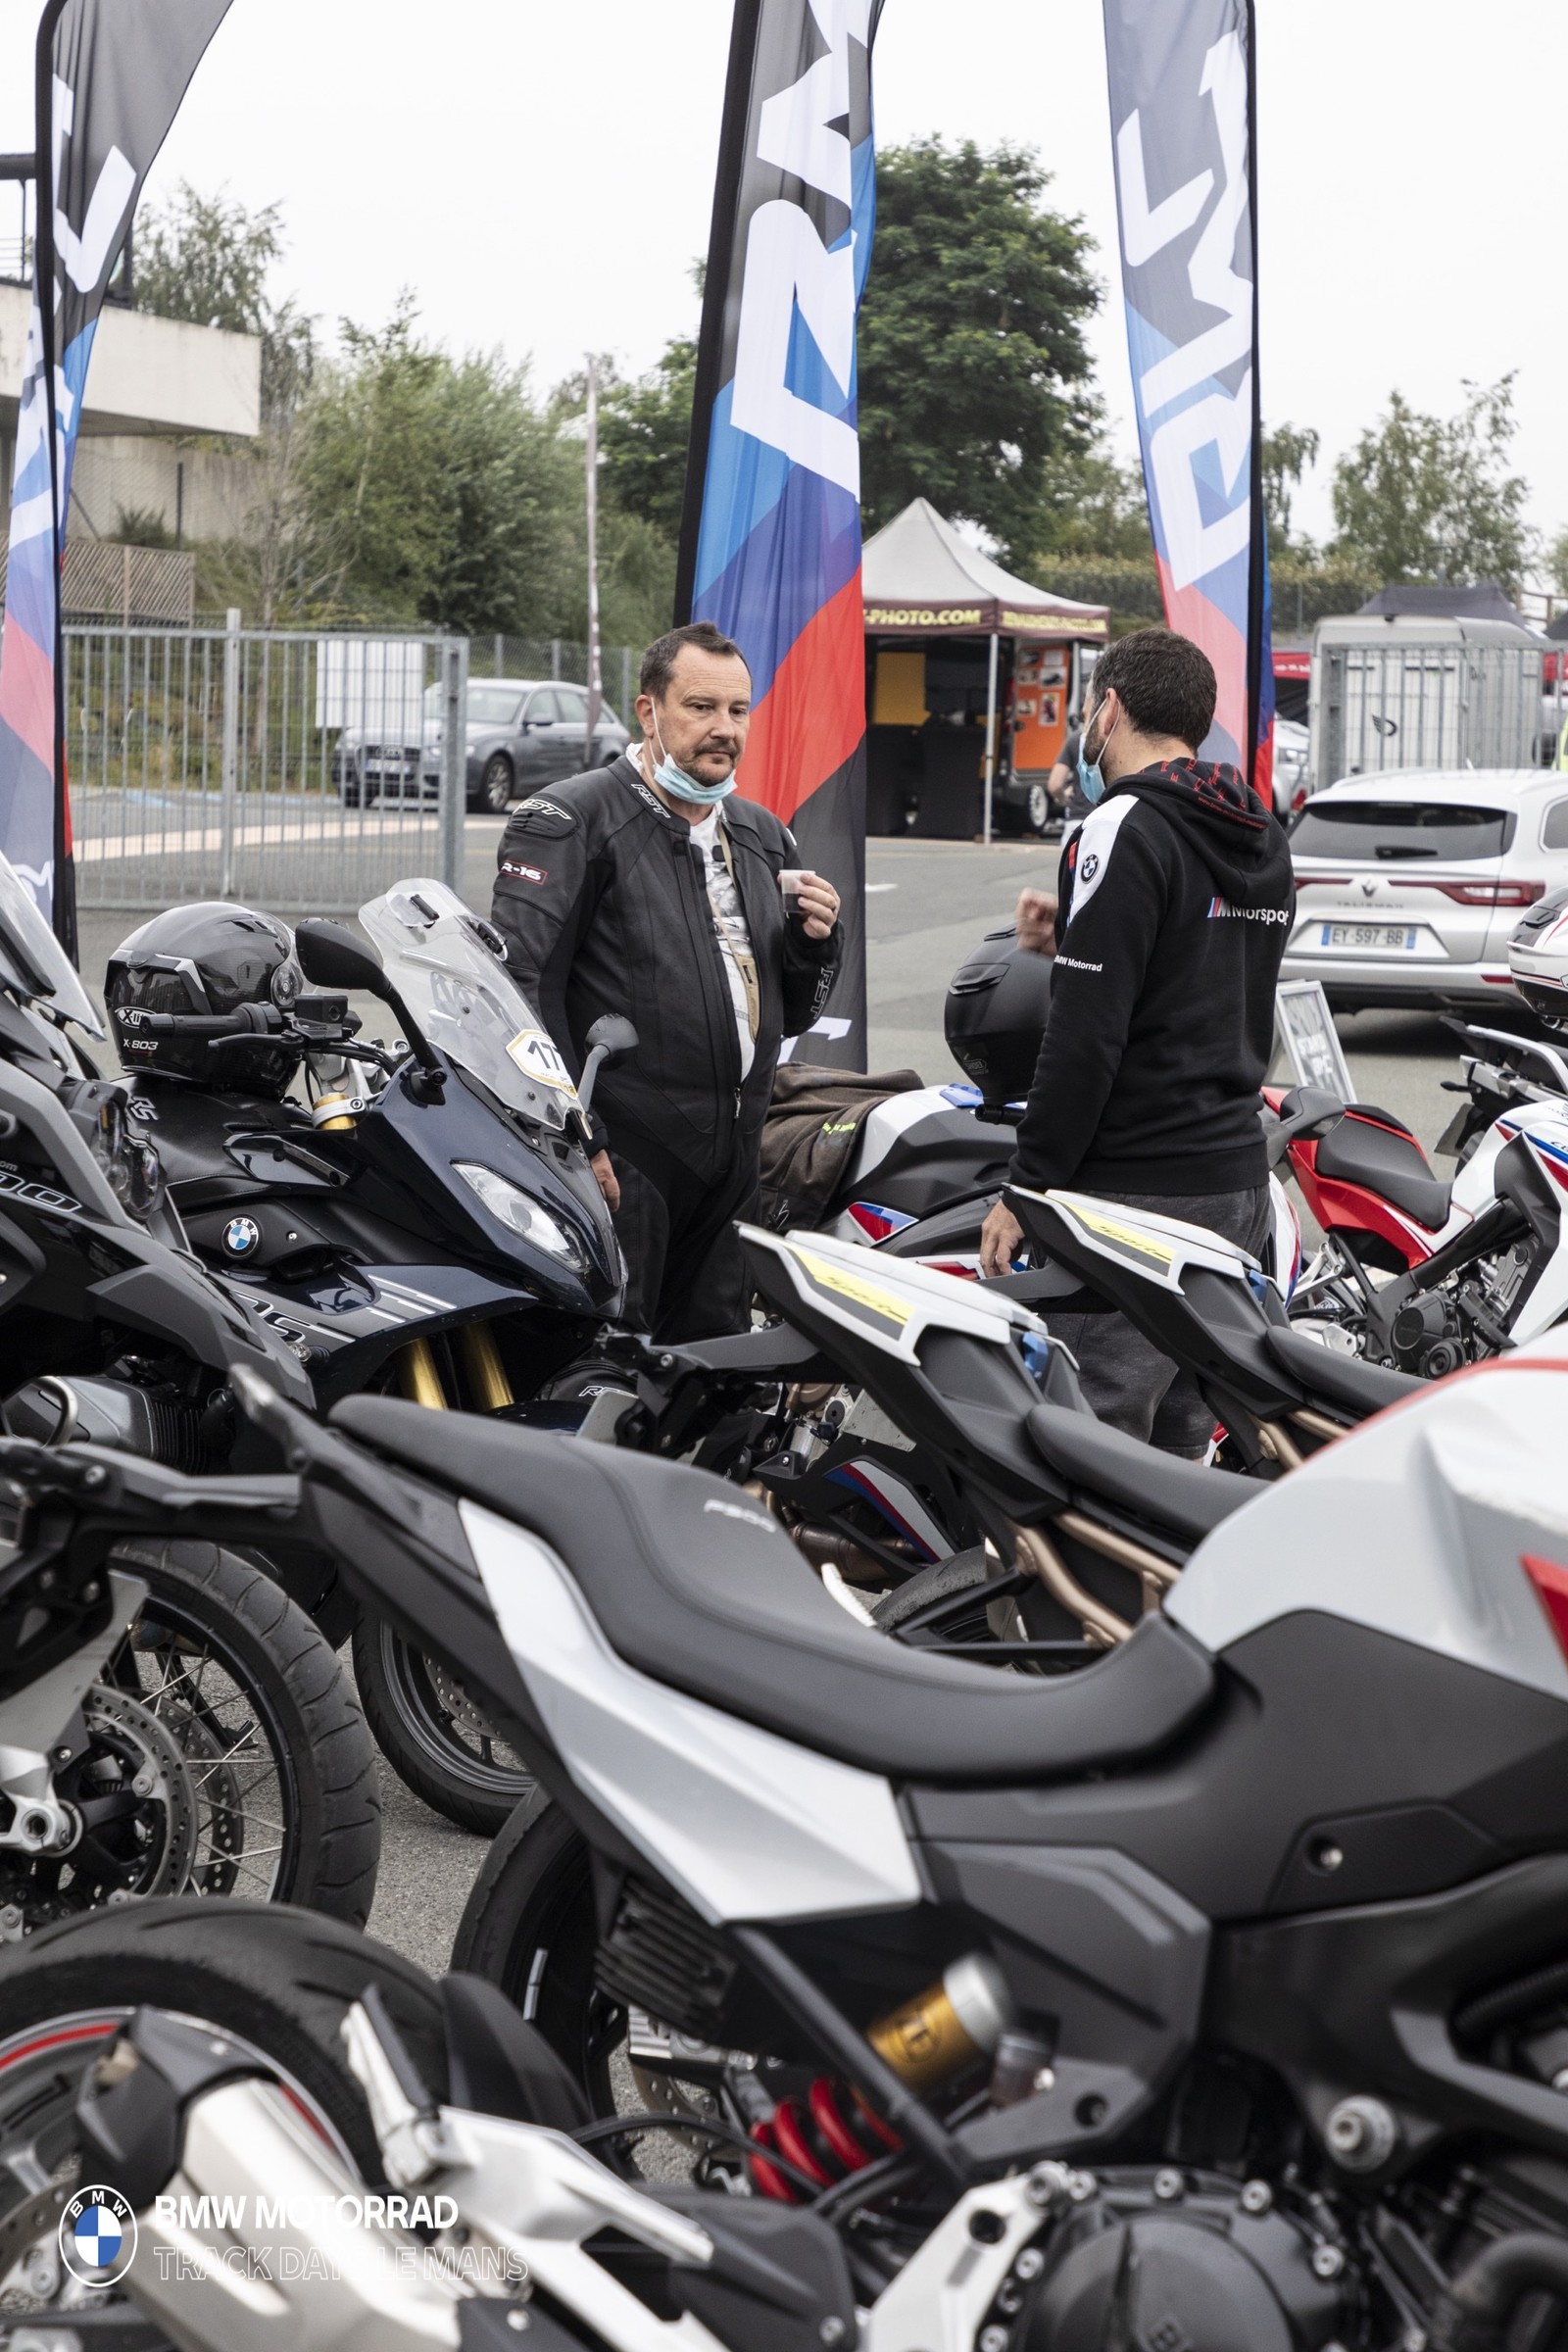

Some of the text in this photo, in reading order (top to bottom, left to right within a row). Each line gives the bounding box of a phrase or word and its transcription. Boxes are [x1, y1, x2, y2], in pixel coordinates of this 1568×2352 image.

[862, 608, 981, 625] -PHOTO.COM
[512, 799, 572, 820] RST
[631, 783, 671, 819] RST
[1068, 957, 1102, 972] Motorrad
[809, 964, 834, 1020] RST
